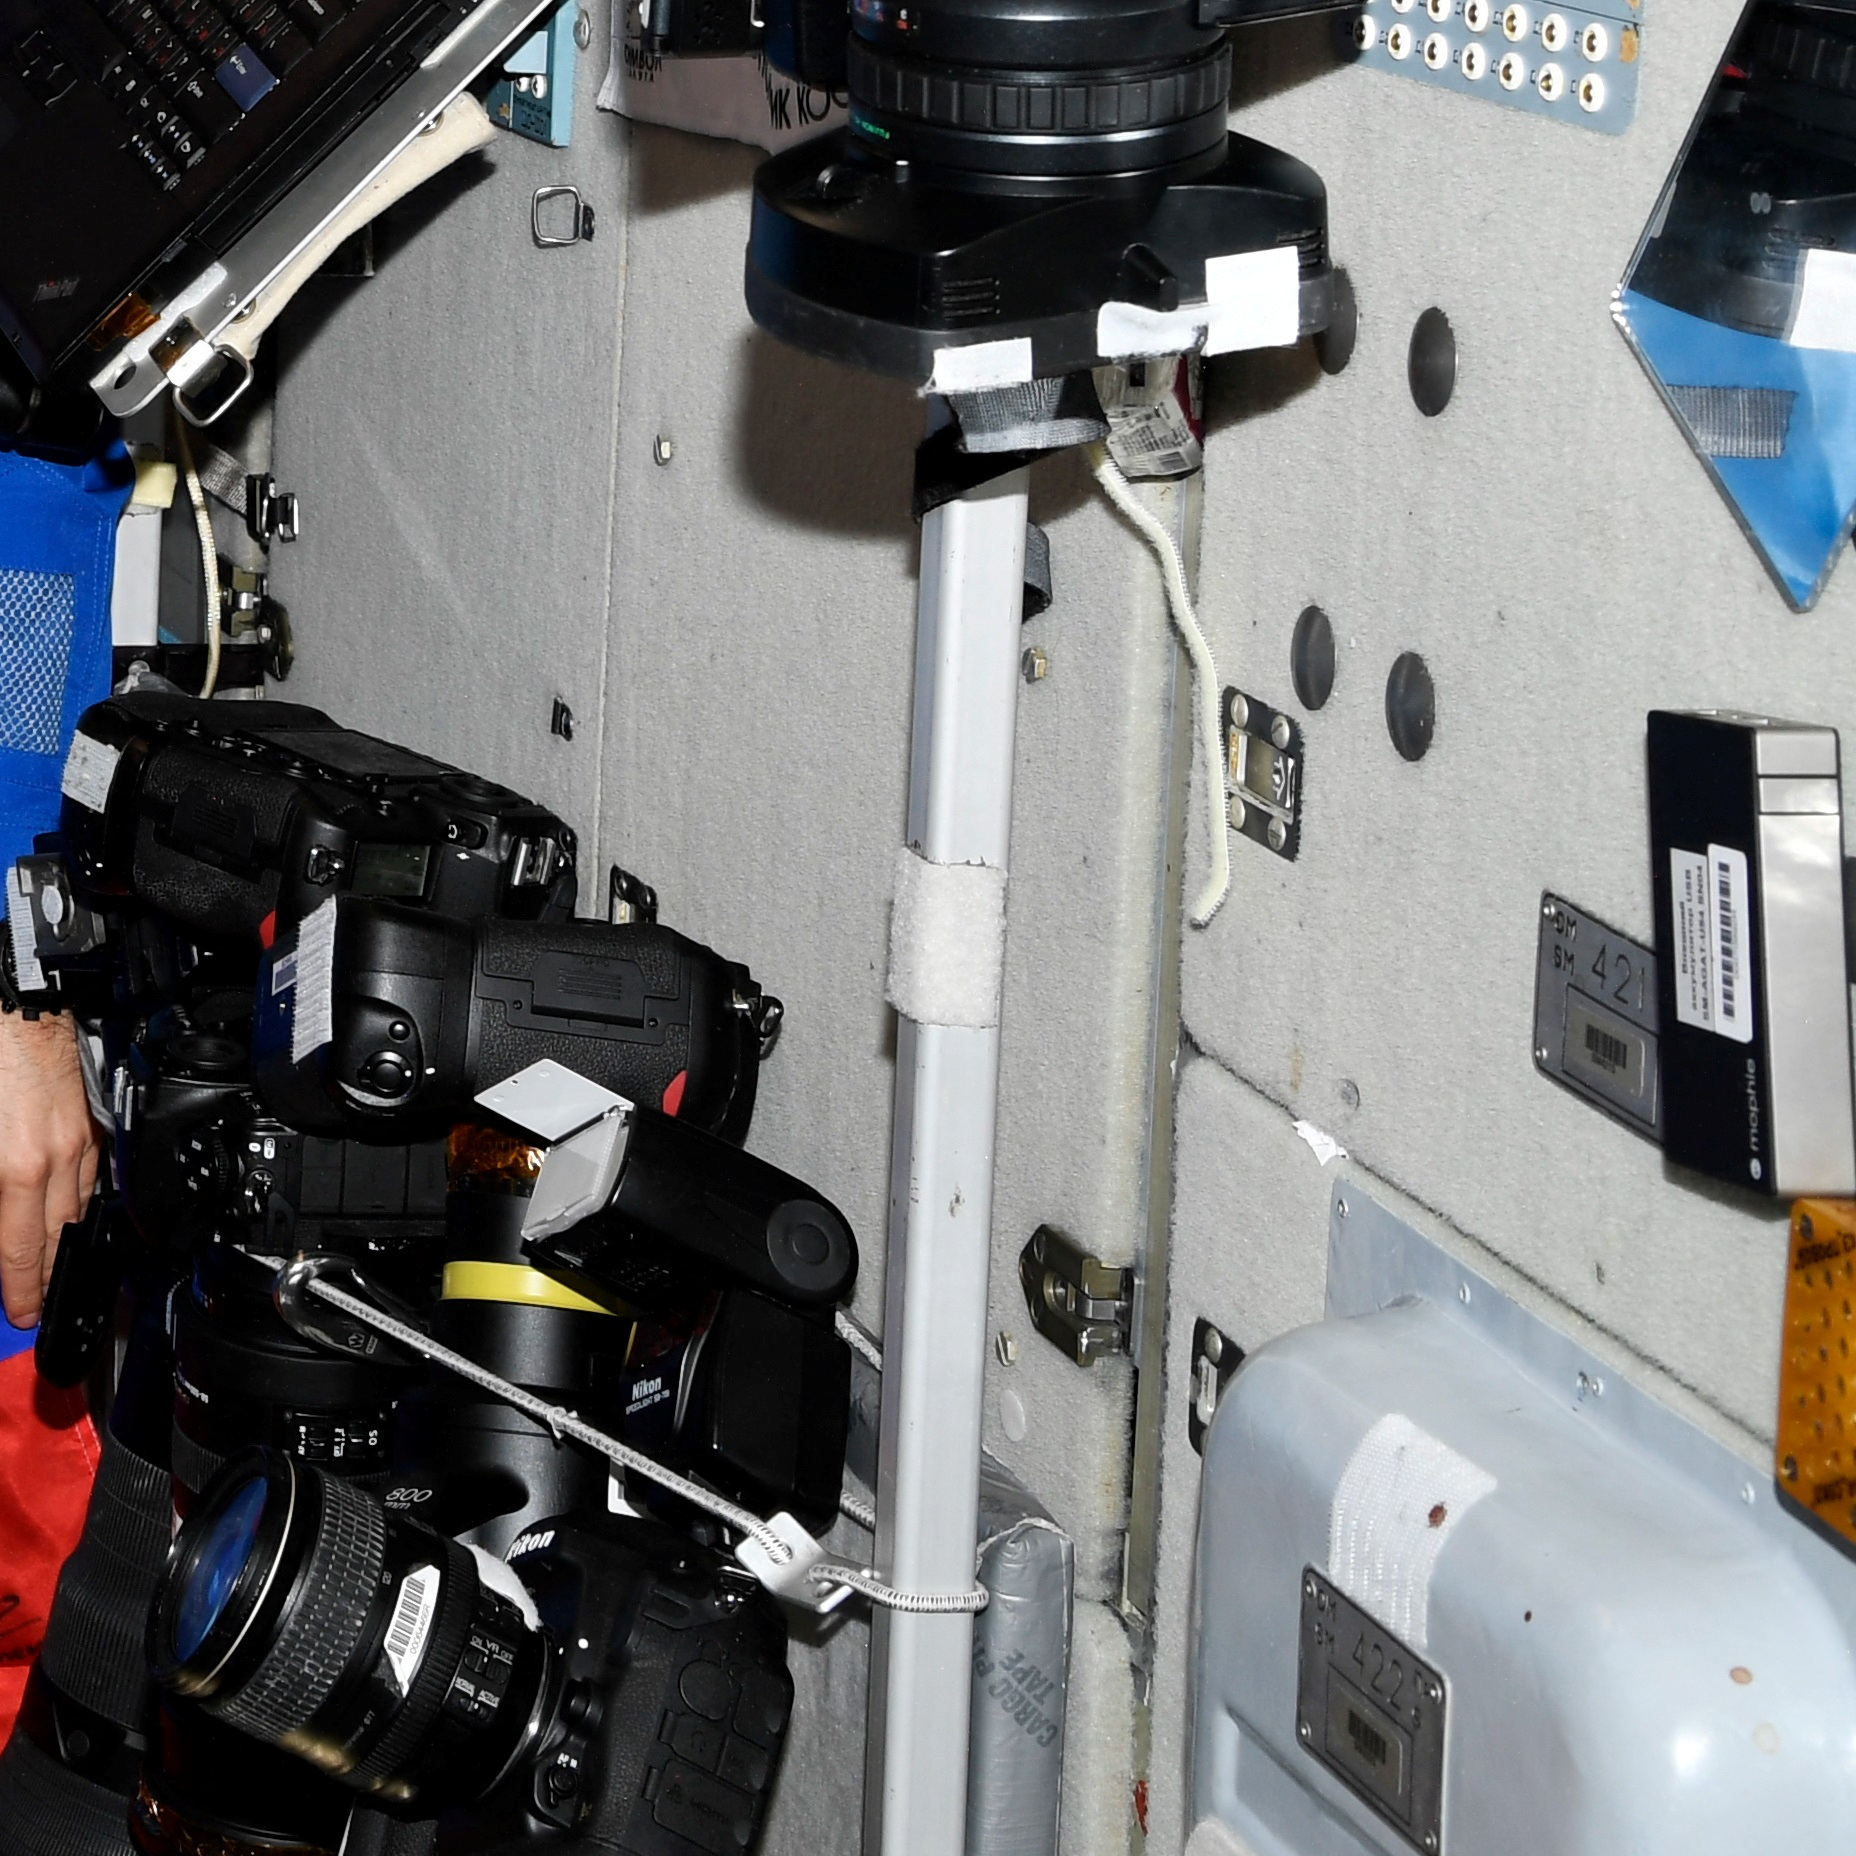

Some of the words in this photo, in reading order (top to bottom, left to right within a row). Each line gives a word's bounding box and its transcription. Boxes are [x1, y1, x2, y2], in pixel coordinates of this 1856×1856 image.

[1591, 944, 1644, 1013] 421
[1744, 1058, 1761, 1152] mophie
[632, 1376, 662, 1402] Nikon
[385, 1488, 433, 1503] 800
[504, 1530, 556, 1565] Nikon
[486, 1639, 500, 1654] VR
[998, 1648, 1054, 1705] TAPE
[1352, 1632, 1404, 1712] 422
